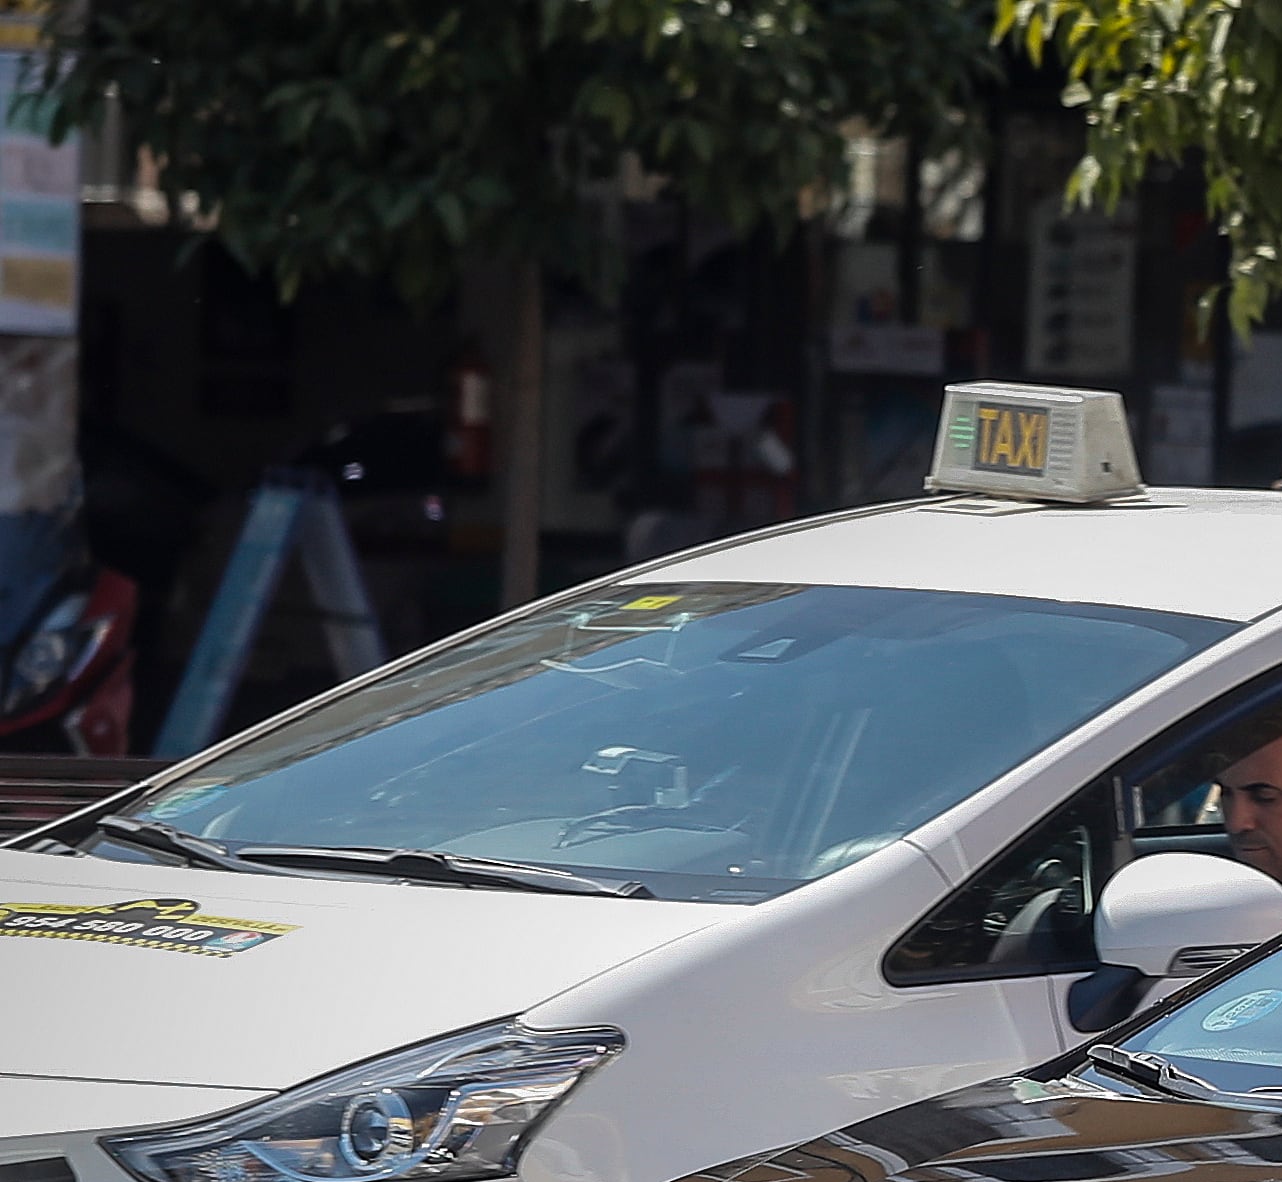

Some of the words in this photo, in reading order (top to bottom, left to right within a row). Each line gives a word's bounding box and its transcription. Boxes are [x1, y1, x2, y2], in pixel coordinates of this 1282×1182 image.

[979, 408, 1048, 469] TAXI
[4, 916, 70, 928] 954
[72, 918, 138, 934] 580
[142, 923, 215, 942] 000
